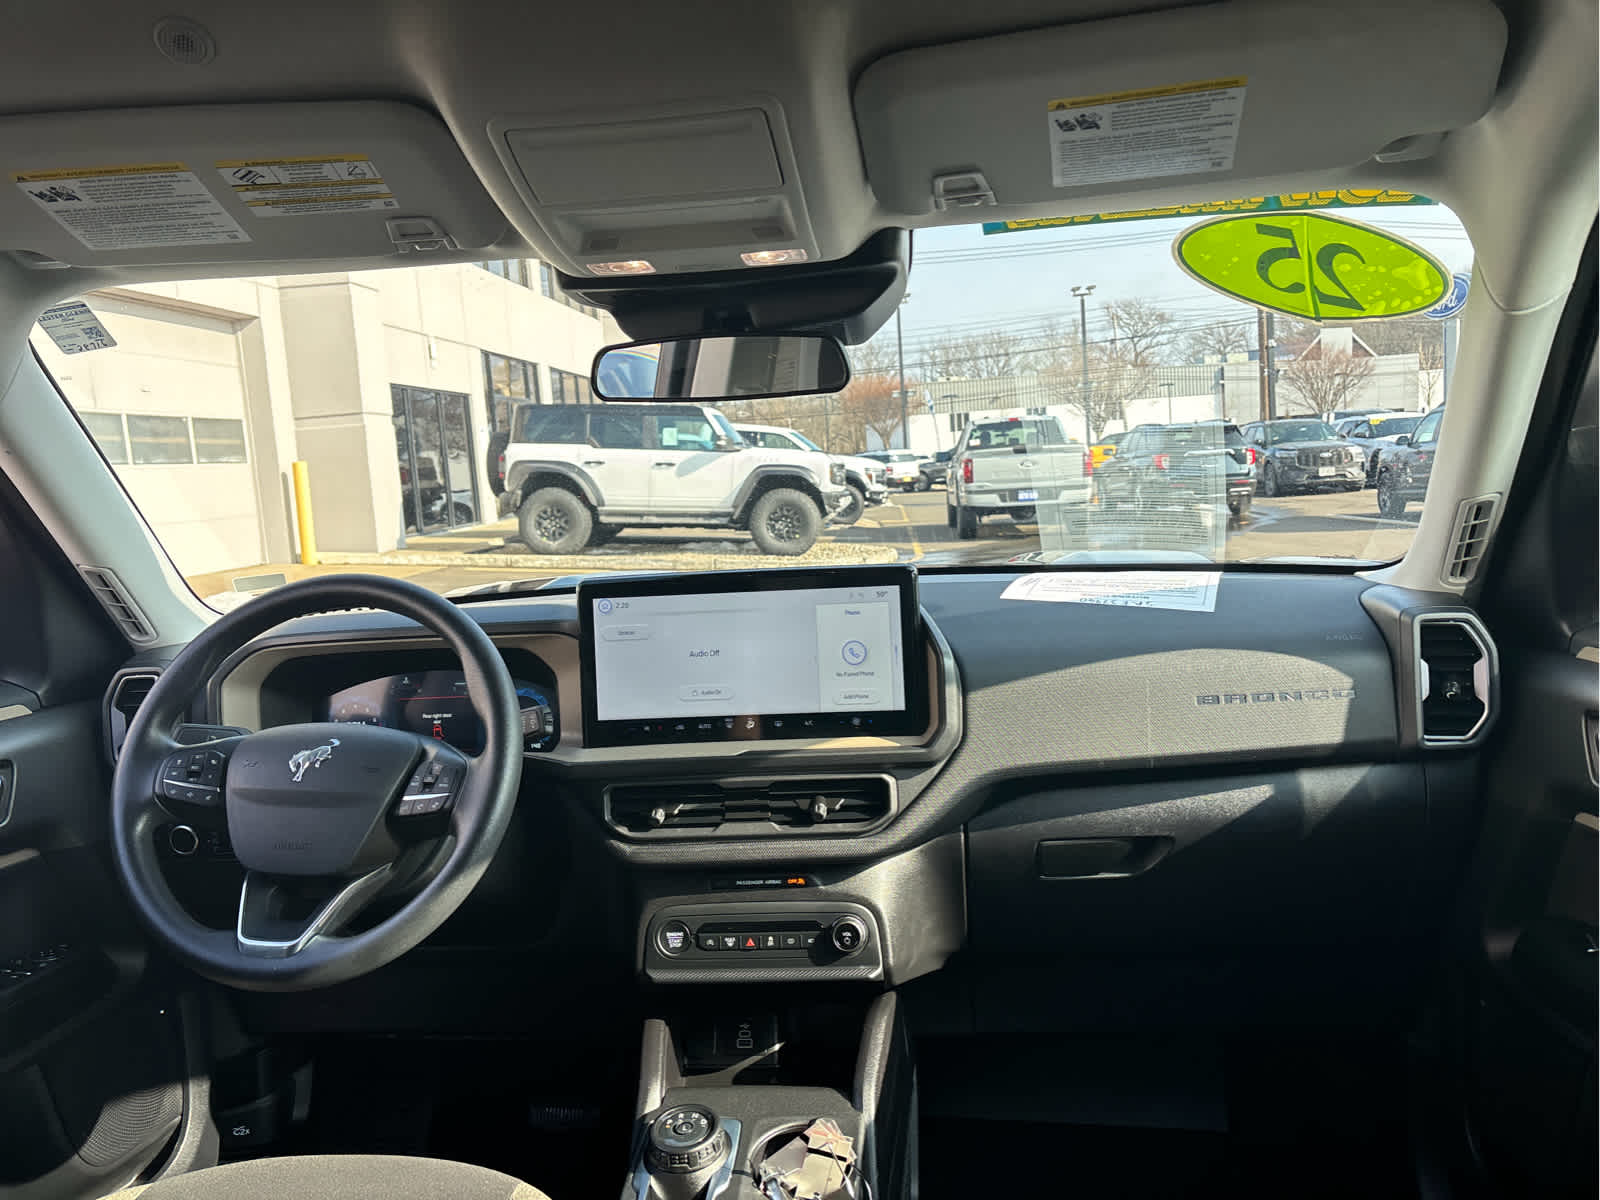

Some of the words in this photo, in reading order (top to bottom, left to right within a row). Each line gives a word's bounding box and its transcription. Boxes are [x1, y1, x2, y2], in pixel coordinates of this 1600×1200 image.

[688, 650, 709, 658] Audio
[709, 649, 720, 657] Off
[1195, 689, 1356, 705] BRONCO
